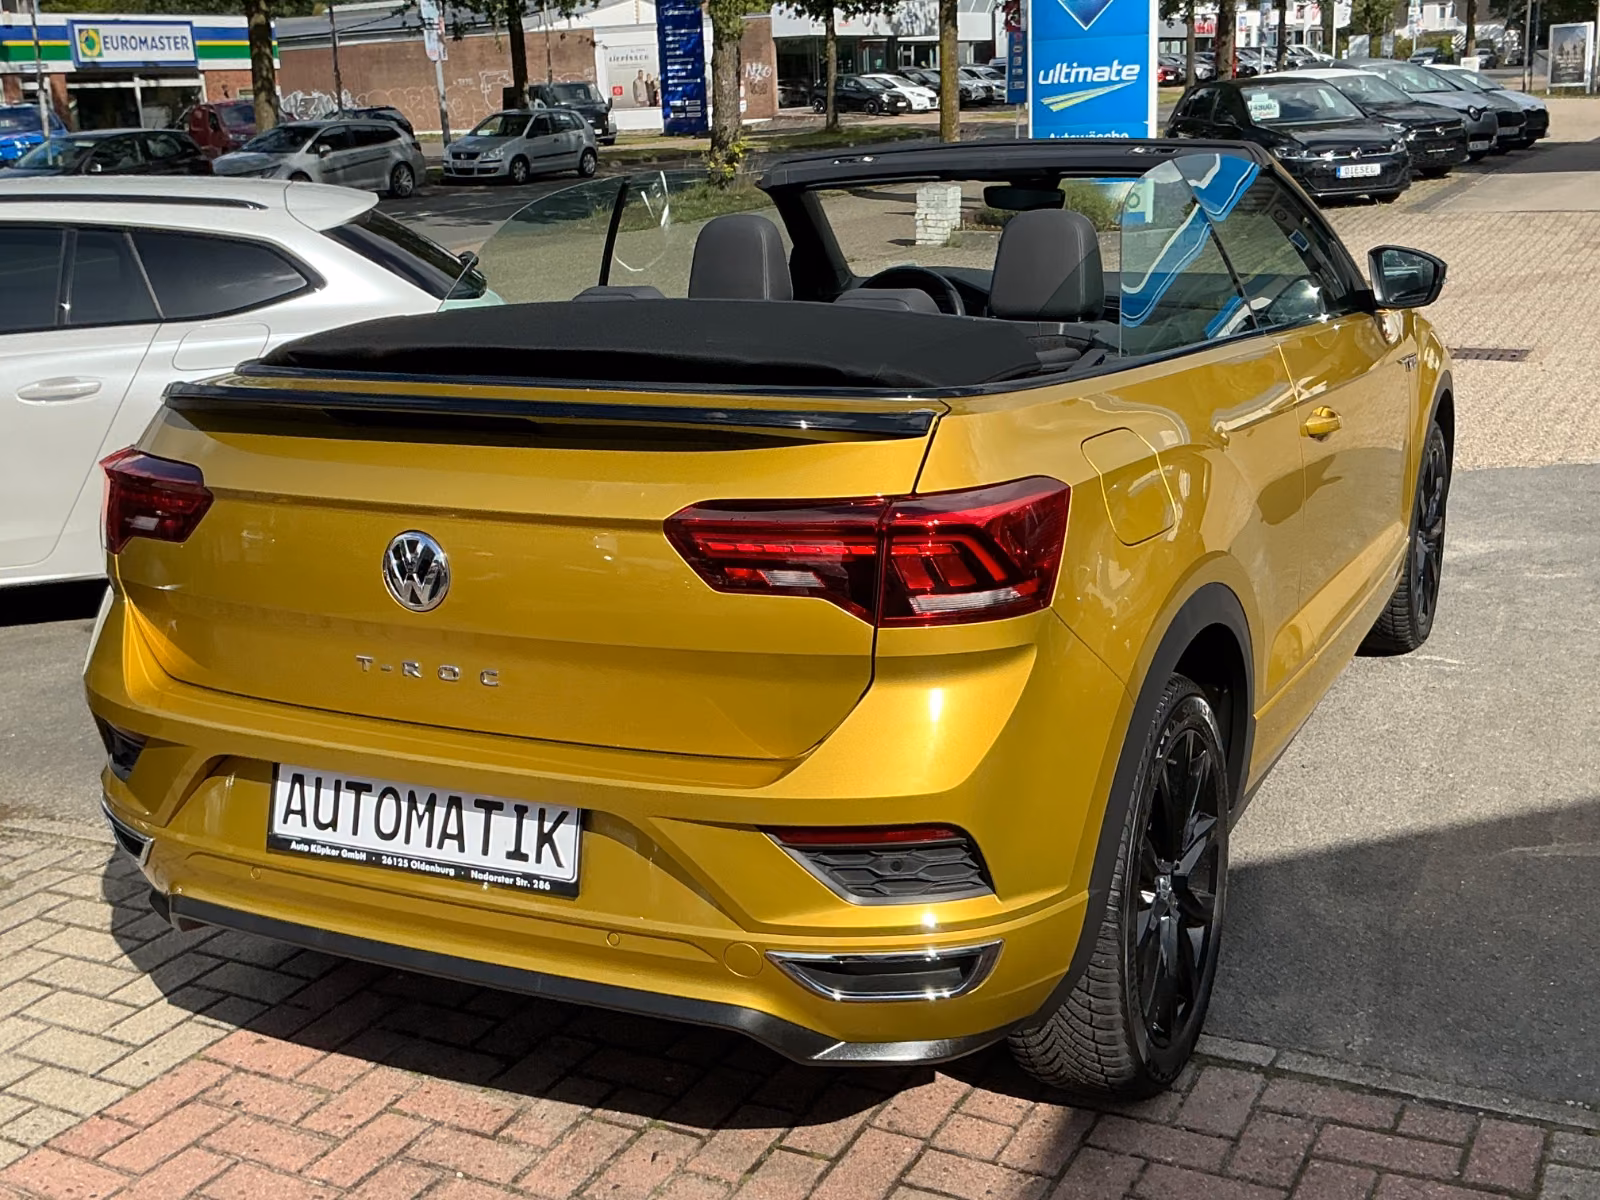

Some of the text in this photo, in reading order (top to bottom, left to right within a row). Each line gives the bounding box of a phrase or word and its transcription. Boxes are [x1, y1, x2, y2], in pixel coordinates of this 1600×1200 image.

[103, 35, 190, 51] EUROMASTER
[1038, 59, 1141, 85] ultimate
[282, 772, 569, 869] AUTOMATIK
[290, 840, 309, 852] Auto
[310, 844, 340, 858] Küpker
[341, 849, 367, 861] GmbH
[381, 855, 409, 868] 26125
[410, 860, 455, 876] Oldenburg
[515, 876, 531, 888] Str.
[533, 880, 551, 891] 286
